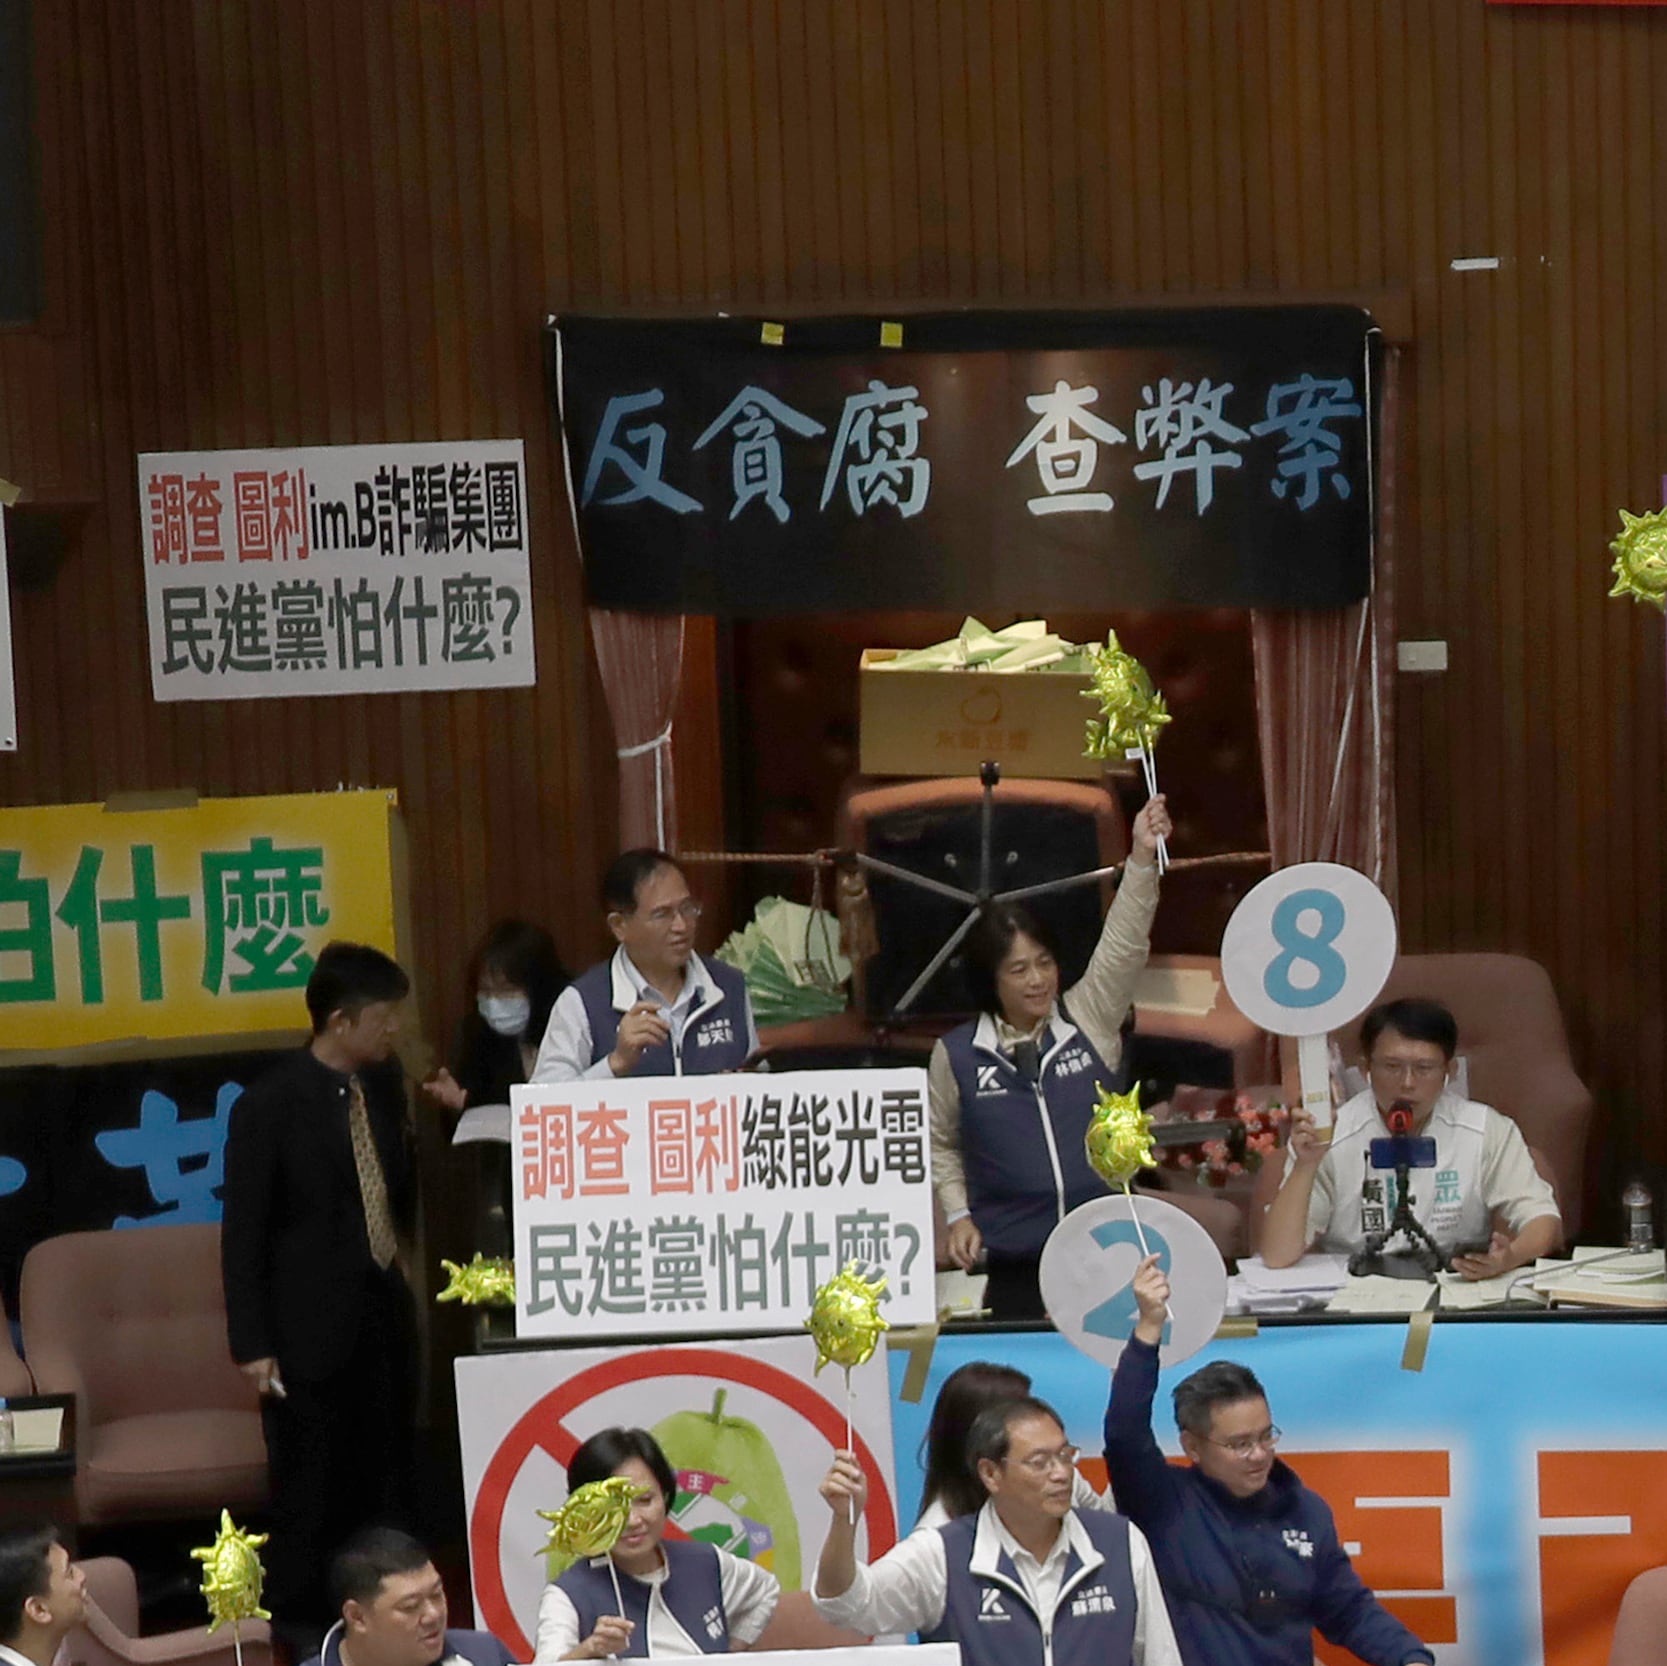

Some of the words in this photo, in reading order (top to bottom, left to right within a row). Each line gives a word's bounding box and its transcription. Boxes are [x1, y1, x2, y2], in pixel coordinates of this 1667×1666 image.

[582, 379, 931, 524] 反貪腐
[1005, 373, 1363, 517] 查弊案
[149, 472, 226, 565] 調查
[235, 461, 525, 564] 圖利im.B詐騙集團
[160, 573, 523, 676] 民進黨怕什麼?
[1264, 887, 1348, 1010] 8
[520, 1101, 630, 1200] 調查
[648, 1087, 927, 1197] 圖利綠能光電
[1080, 1218, 1173, 1346] 2
